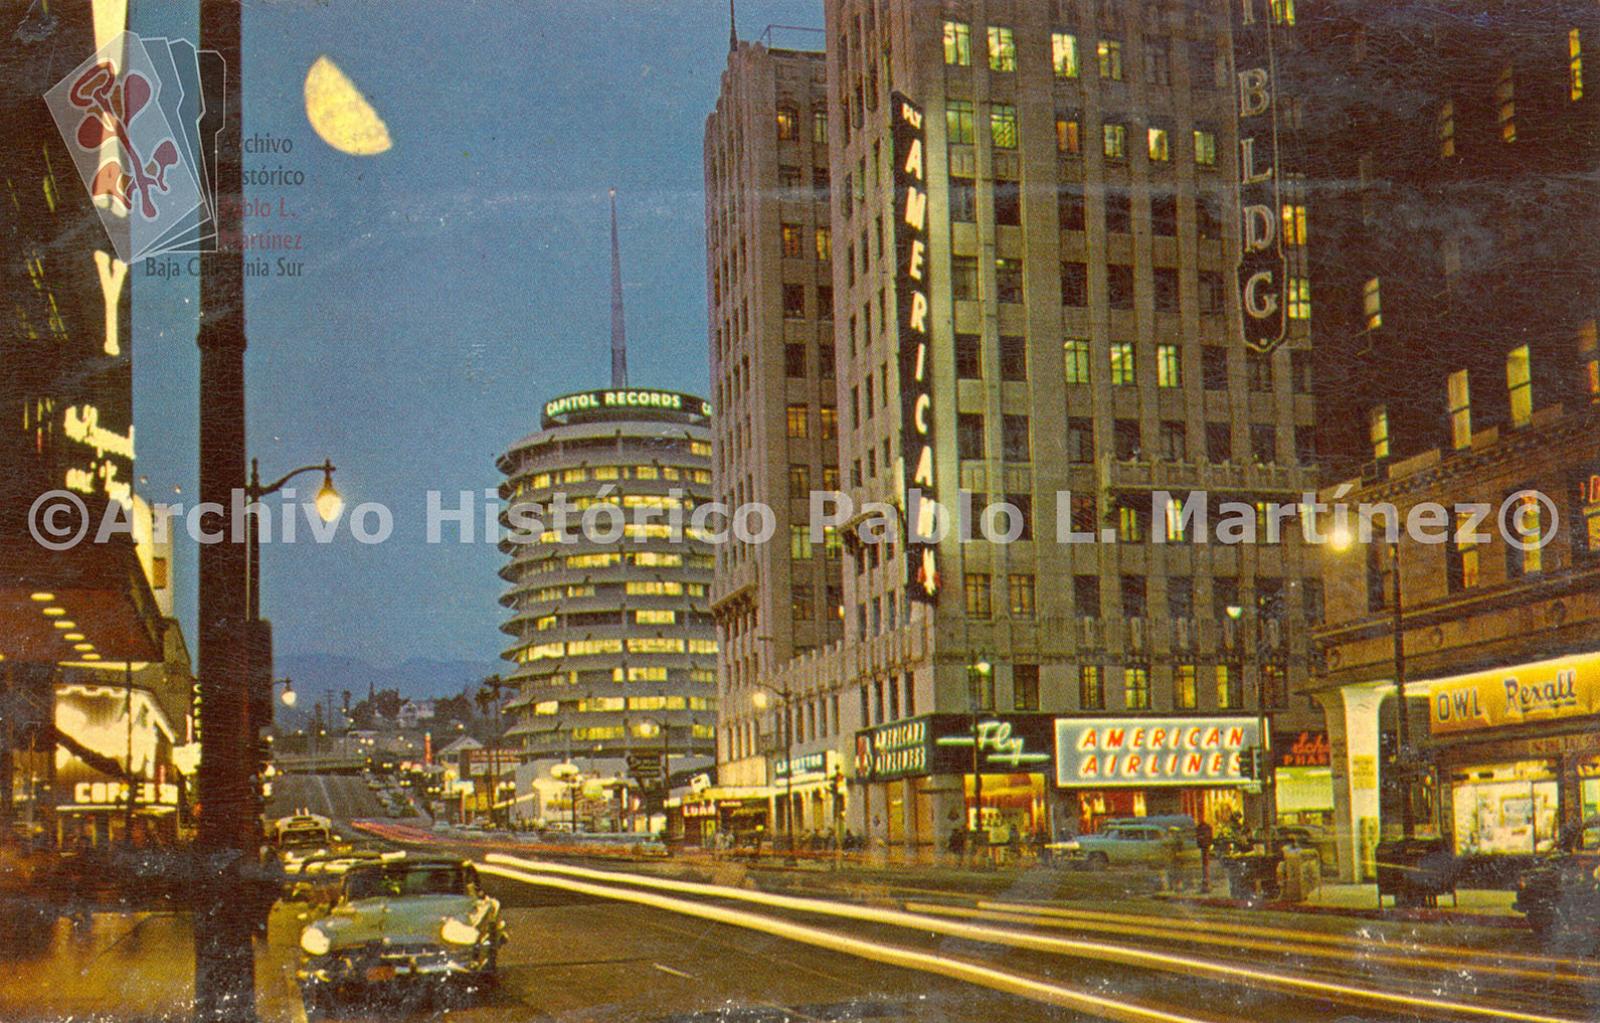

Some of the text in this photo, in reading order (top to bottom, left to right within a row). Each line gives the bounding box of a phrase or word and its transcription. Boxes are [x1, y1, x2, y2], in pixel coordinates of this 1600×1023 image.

[1238, 68, 1278, 319] BLDG
[904, 138, 936, 539] AMERICAN
[547, 394, 599, 416] CAPITOL
[604, 391, 682, 409] RECORDS
[1436, 669, 1577, 722] OWL Rexall
[973, 721, 1025, 767] Fly
[1078, 727, 1245, 750] AMERICAN
[1079, 754, 1242, 777] AIRLINES
